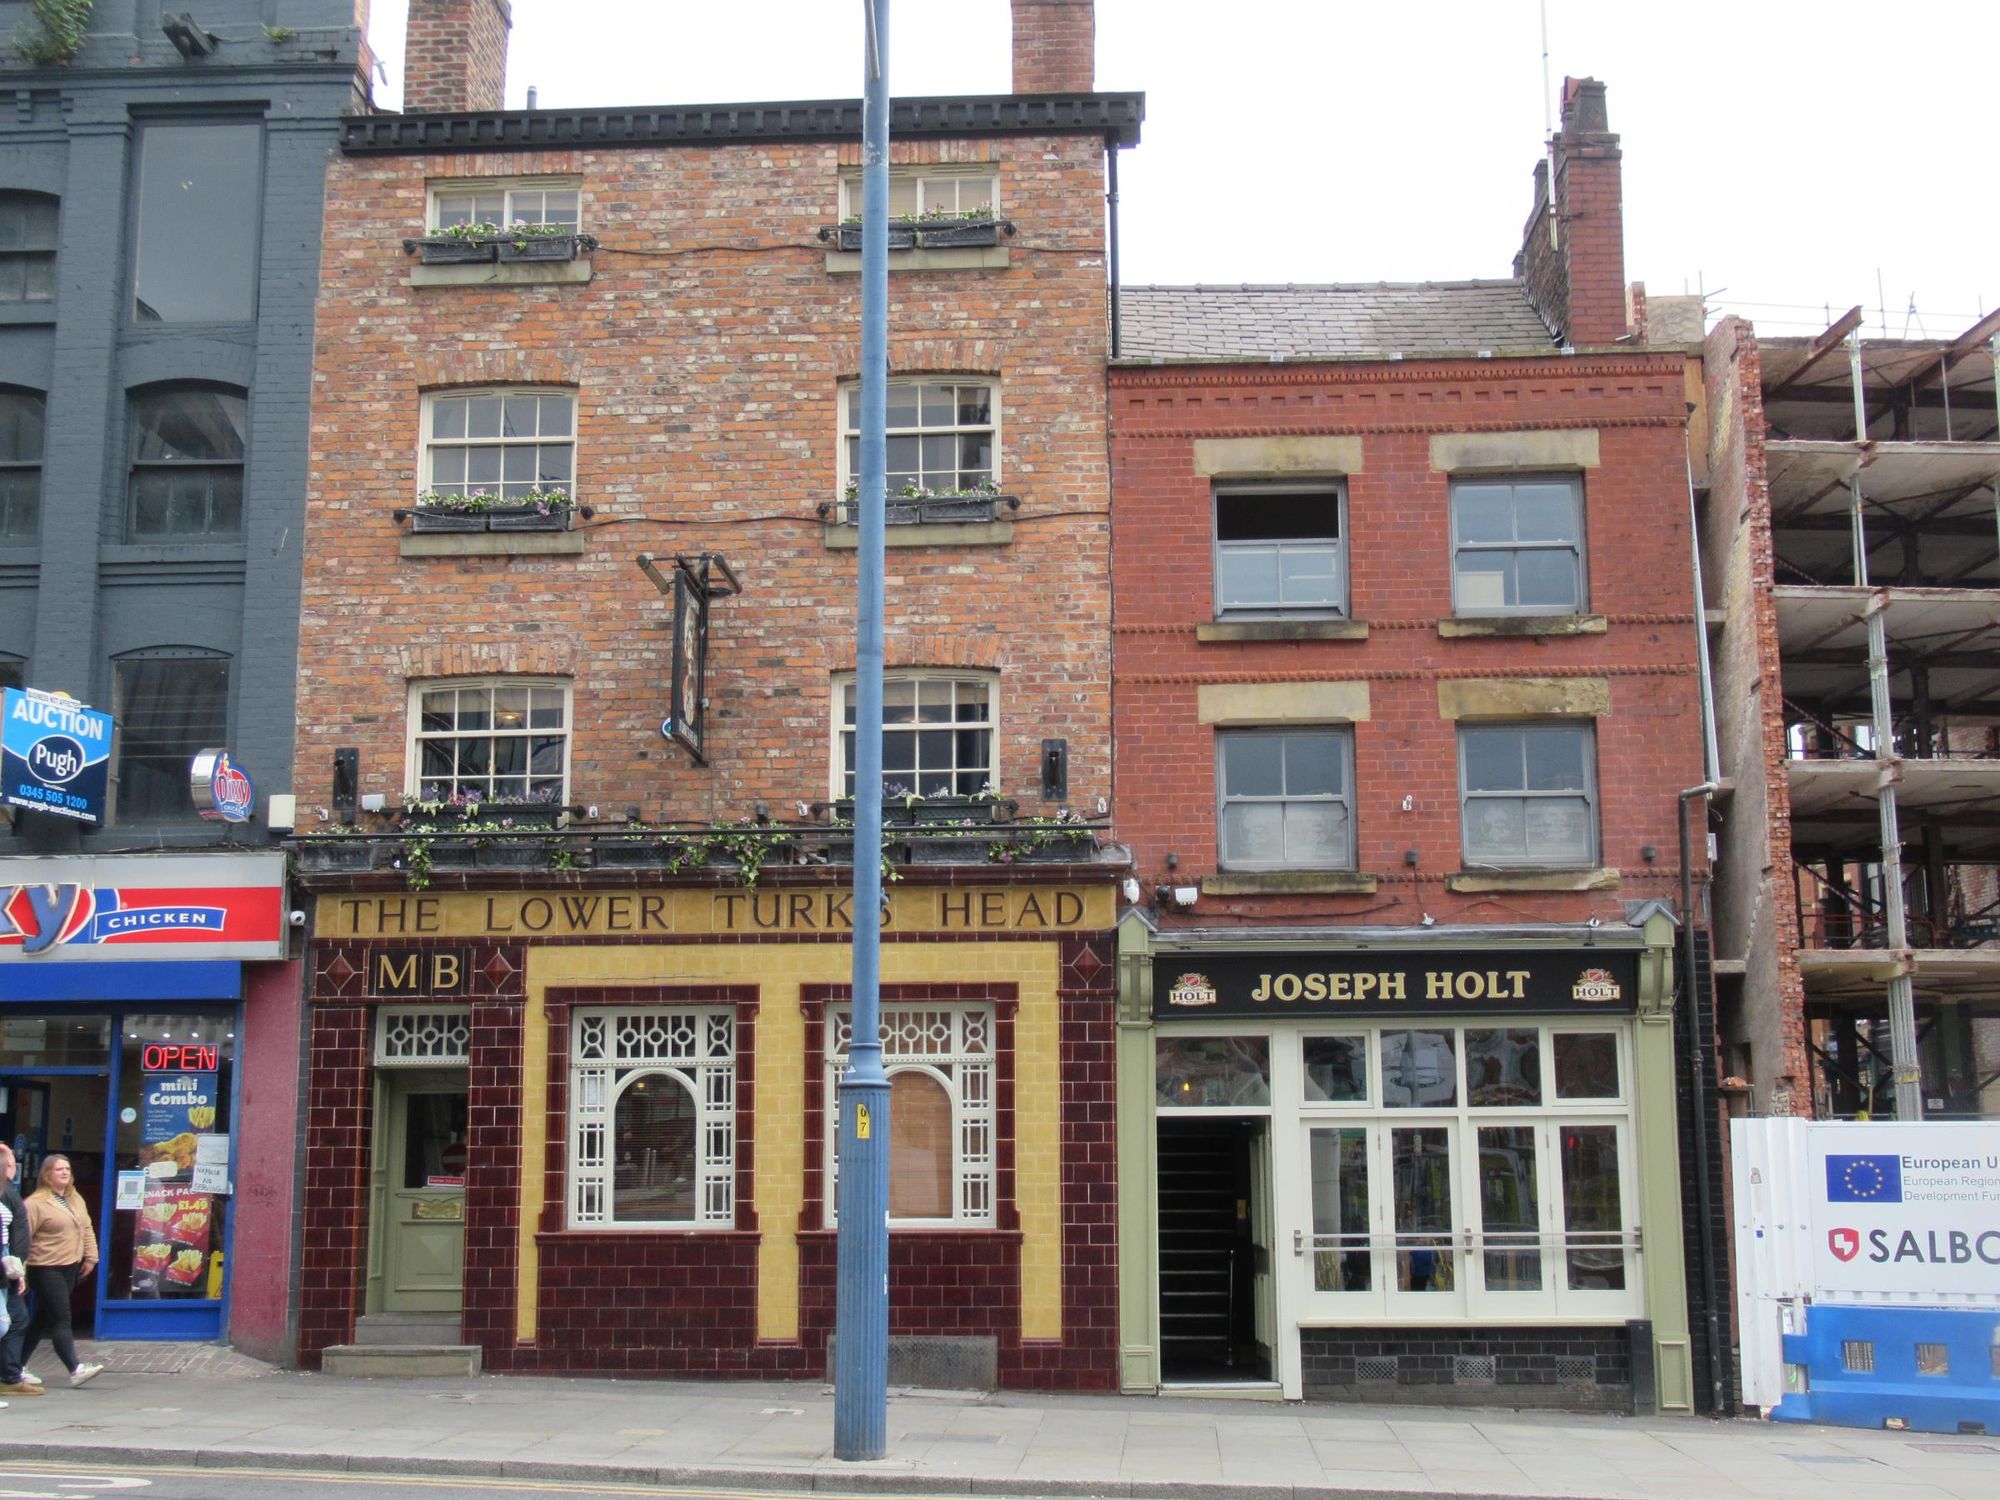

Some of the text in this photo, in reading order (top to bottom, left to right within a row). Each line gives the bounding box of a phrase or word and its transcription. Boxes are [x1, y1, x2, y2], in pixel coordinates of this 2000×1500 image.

[13, 698, 103, 740] AUCTION
[36, 743, 77, 776] Pugh
[20, 784, 44, 799] 0345
[46, 790, 63, 804] 505
[66, 795, 87, 810] 1200
[341, 899, 440, 933] THE
[486, 896, 669, 931] LOWER
[941, 891, 1083, 927] HEAD
[108, 913, 207, 929] CHICKEN
[1252, 971, 1531, 1001] JOSEPH HOLT
[1576, 988, 1617, 997] HOLT
[1172, 992, 1214, 1001] HOLT
[144, 1045, 217, 1070] OPEN
[150, 1092, 208, 1106] Combo
[1902, 1156, 1981, 1171] European
[1904, 1176, 1957, 1187] European
[1905, 1191, 1978, 1202] Development
